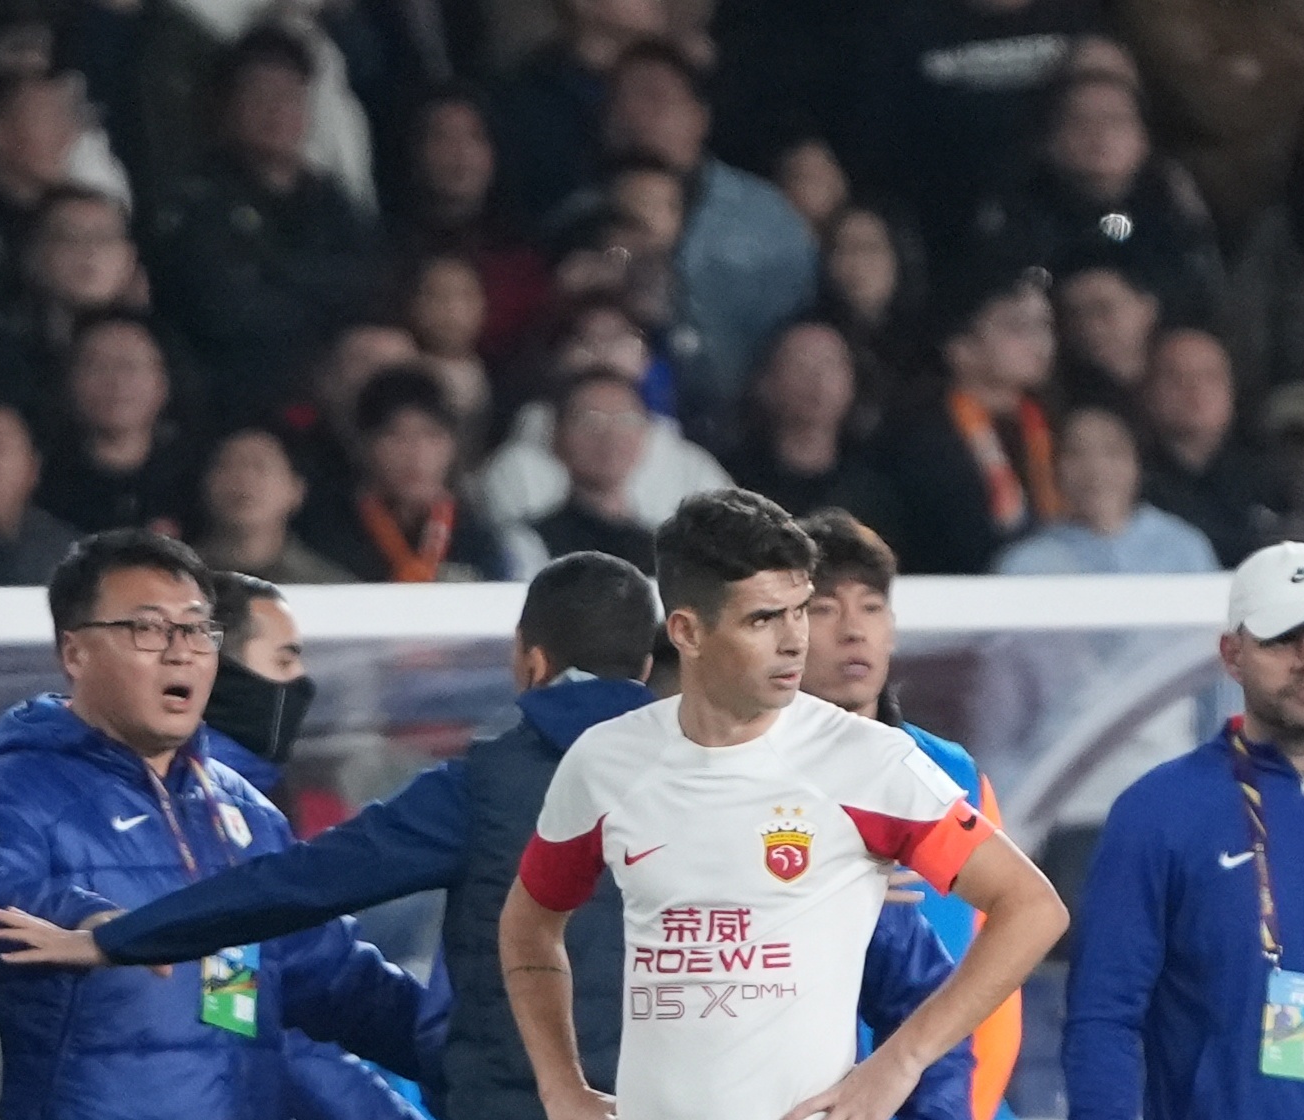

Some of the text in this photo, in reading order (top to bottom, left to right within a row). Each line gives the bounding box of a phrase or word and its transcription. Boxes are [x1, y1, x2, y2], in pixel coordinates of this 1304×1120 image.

[660, 907, 751, 943] 荣威
[633, 943, 791, 974] ROEWE
[741, 983, 797, 999] DMH
